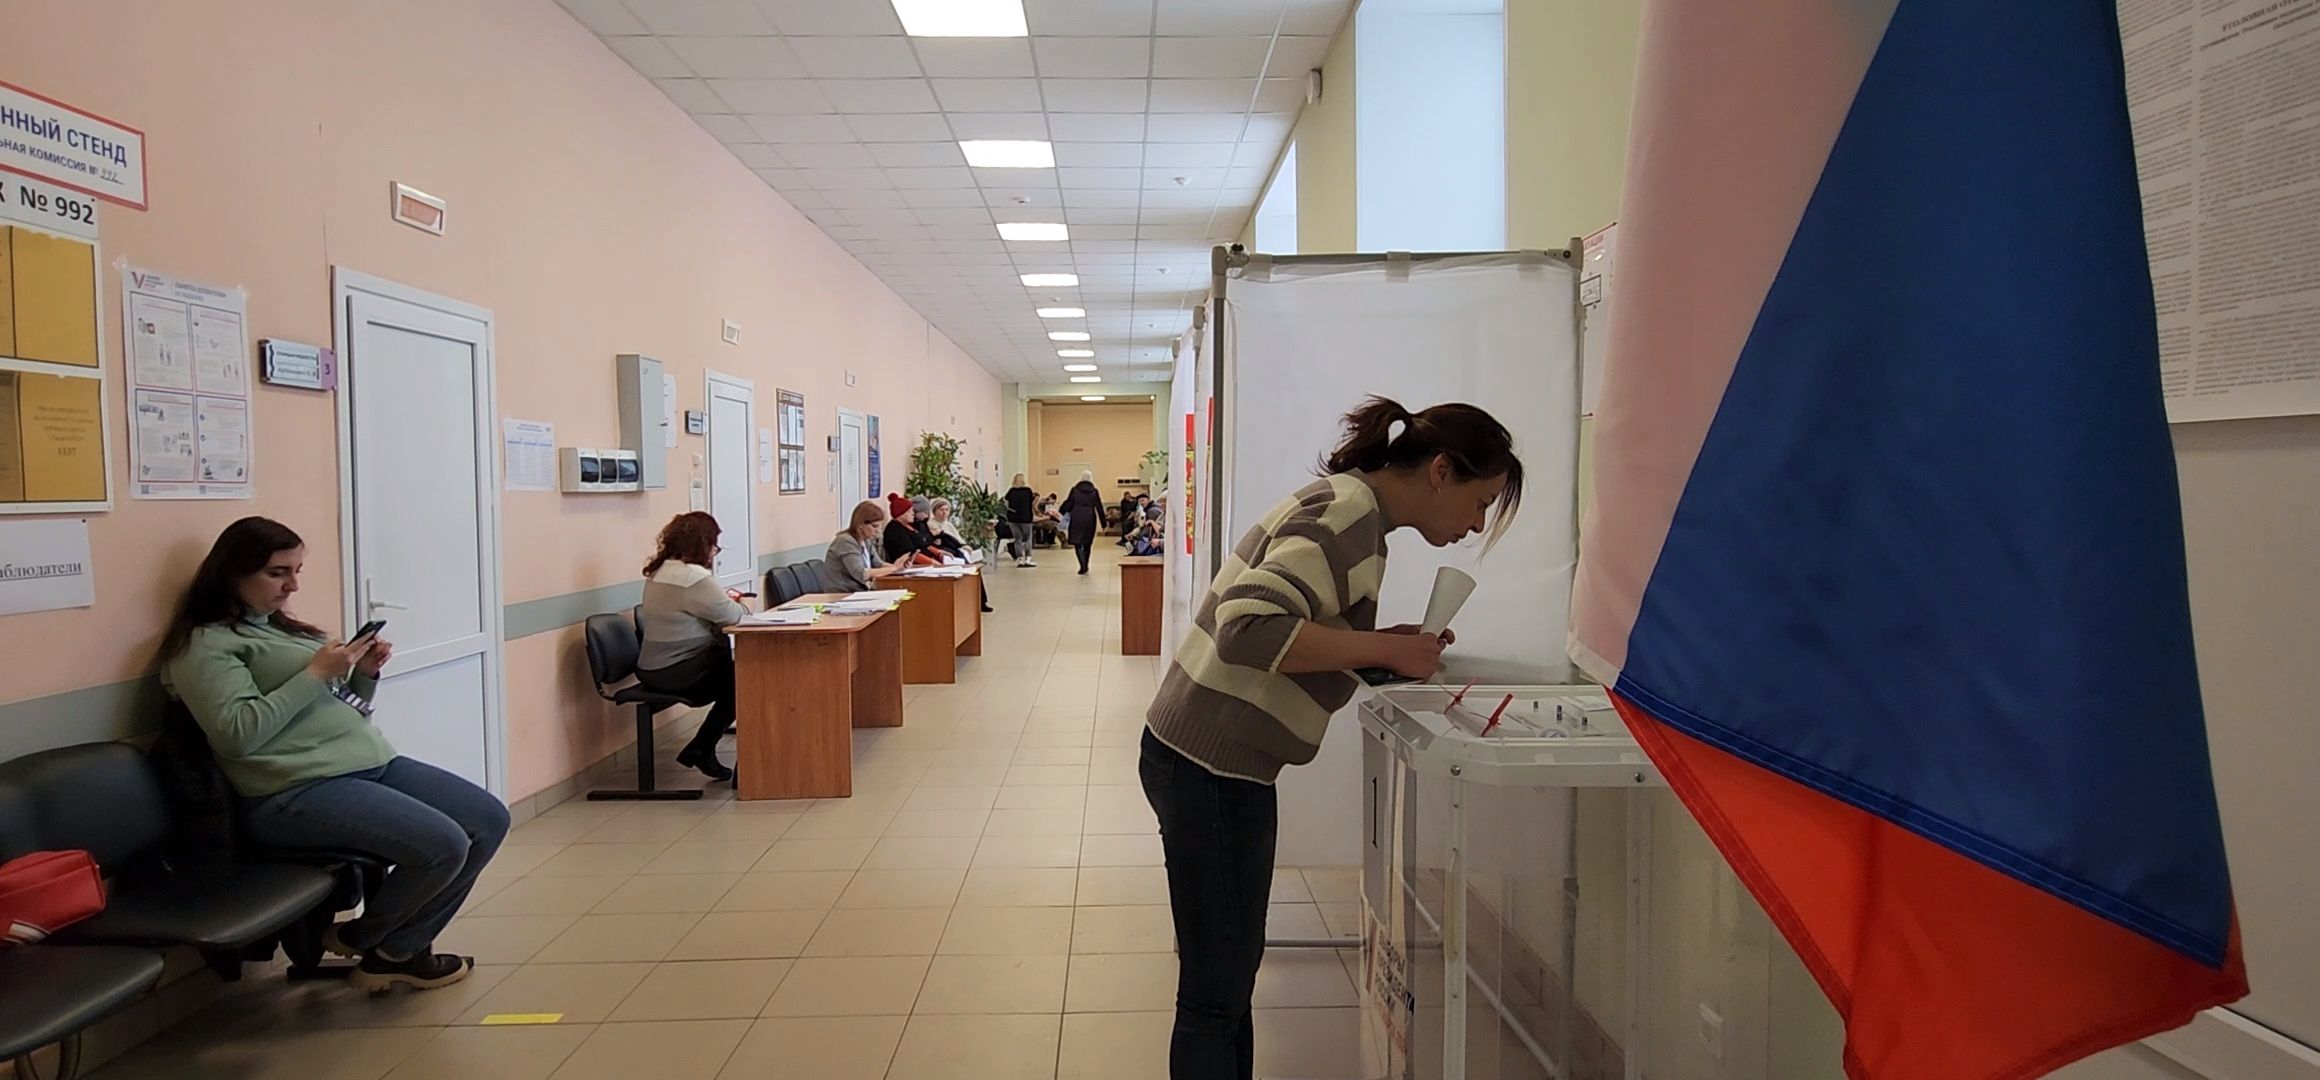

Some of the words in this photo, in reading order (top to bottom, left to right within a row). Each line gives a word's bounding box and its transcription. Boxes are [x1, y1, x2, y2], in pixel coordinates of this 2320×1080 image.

[1, 105, 61, 142] ННЫЙ
[67, 128, 127, 168] СТЕНД
[29, 146, 86, 173] КОМИССИЯ
[20, 186, 48, 212] №
[55, 196, 94, 225] 992
